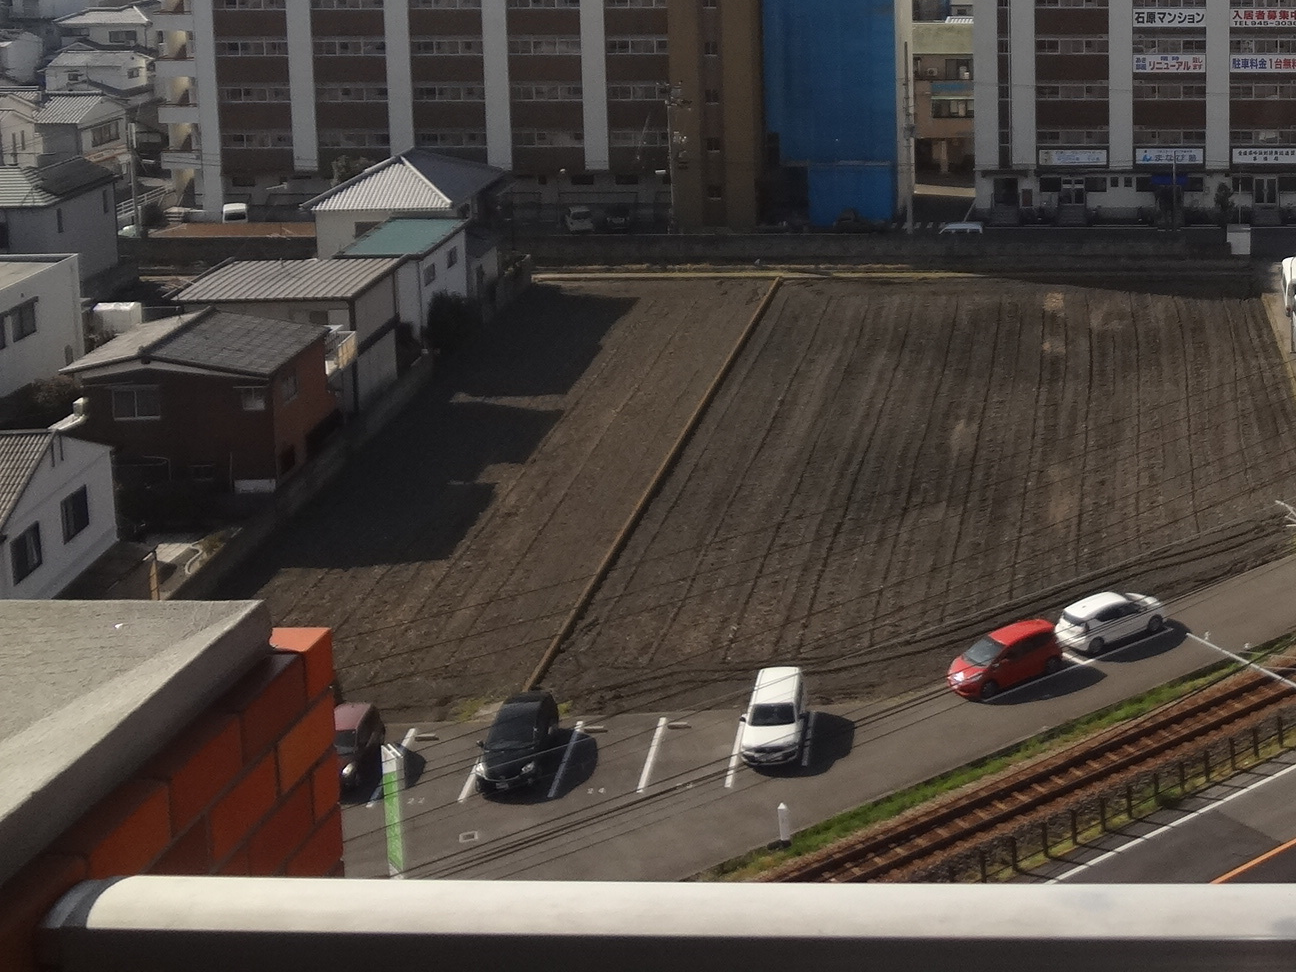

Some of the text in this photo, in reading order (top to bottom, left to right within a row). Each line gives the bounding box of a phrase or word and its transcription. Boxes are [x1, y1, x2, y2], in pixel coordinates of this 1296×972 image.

[1135, 11, 1205, 24] 石原マンション
[1148, 61, 1191, 71] リニューアル
